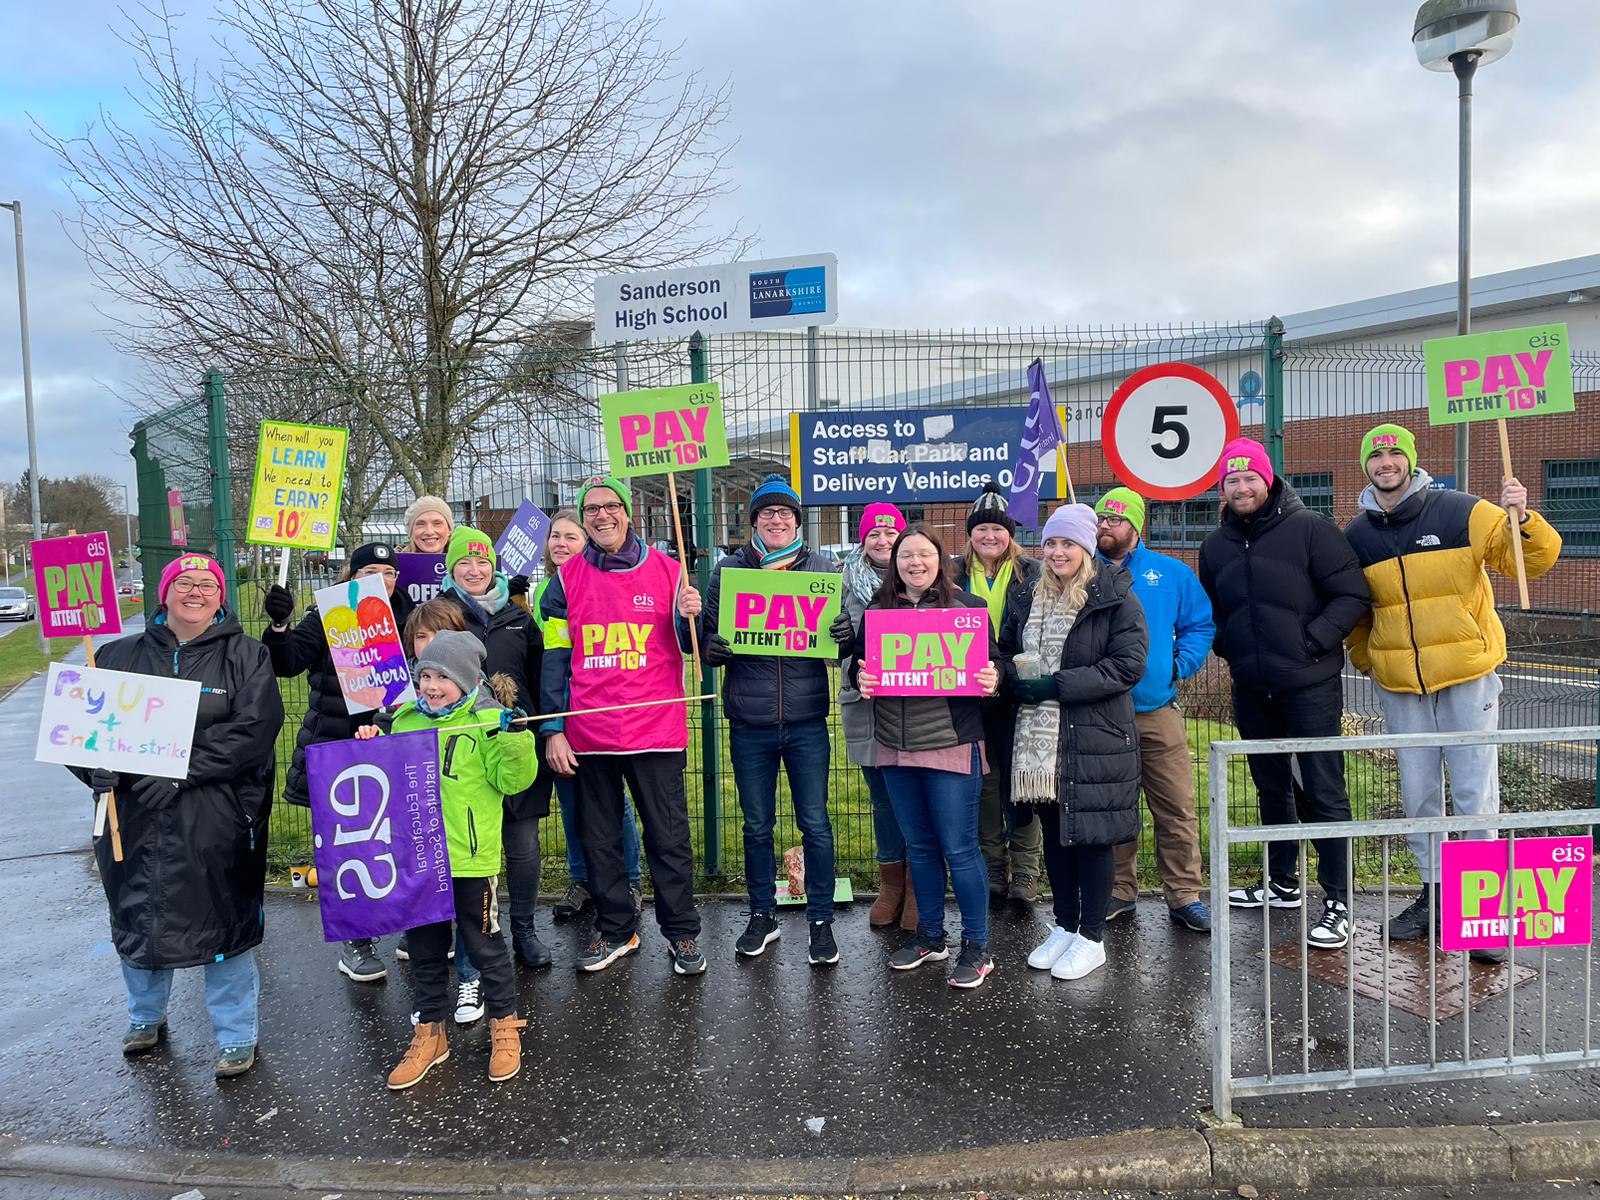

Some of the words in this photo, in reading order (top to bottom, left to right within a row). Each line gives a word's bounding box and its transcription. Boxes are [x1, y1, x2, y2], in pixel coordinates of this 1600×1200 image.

[620, 279, 720, 301] Sanderson
[753, 286, 822, 300] LANARKSHIRE
[615, 308, 657, 330] High
[663, 302, 728, 324] School
[1529, 331, 1561, 349] eis
[1444, 349, 1553, 398] PAY
[688, 389, 715, 406] eis
[265, 426, 293, 443] When
[295, 430, 310, 444] will
[318, 436, 334, 449] you
[619, 406, 710, 453] PAY
[812, 421, 888, 439] Access
[894, 420, 916, 437] to
[1151, 405, 1190, 459] 5
[272, 446, 327, 469] LEARN
[812, 446, 867, 466] Staff
[870, 447, 907, 464] Car
[915, 444, 964, 462] Park
[969, 443, 1009, 462] and
[264, 467, 277, 484] We
[285, 473, 311, 487] need
[321, 474, 332, 488] to
[812, 474, 897, 494] Delivery
[902, 470, 992, 490] Vehicles
[274, 488, 329, 510] EARN?
[275, 509, 312, 540] 10%
[528, 515, 541, 531] eis
[87, 539, 105, 557] eis
[507, 524, 538, 561] OFFICIAL
[500, 541, 527, 574] PICKET
[44, 561, 104, 609] PAY
[809, 579, 836, 595] eis
[633, 592, 654, 607] eis
[735, 591, 829, 632] PAY
[954, 613, 982, 629] eis
[328, 616, 393, 649] Support
[581, 622, 654, 656] PAY
[352, 646, 382, 666] our
[881, 632, 975, 671] PAY
[338, 665, 408, 694] Teachers
[54, 670, 105, 715] Pay
[50, 723, 99, 753] End
[107, 736, 133, 753] the
[138, 738, 187, 760] strike
[1552, 843, 1586, 863] eis
[1461, 867, 1578, 918] PAY
